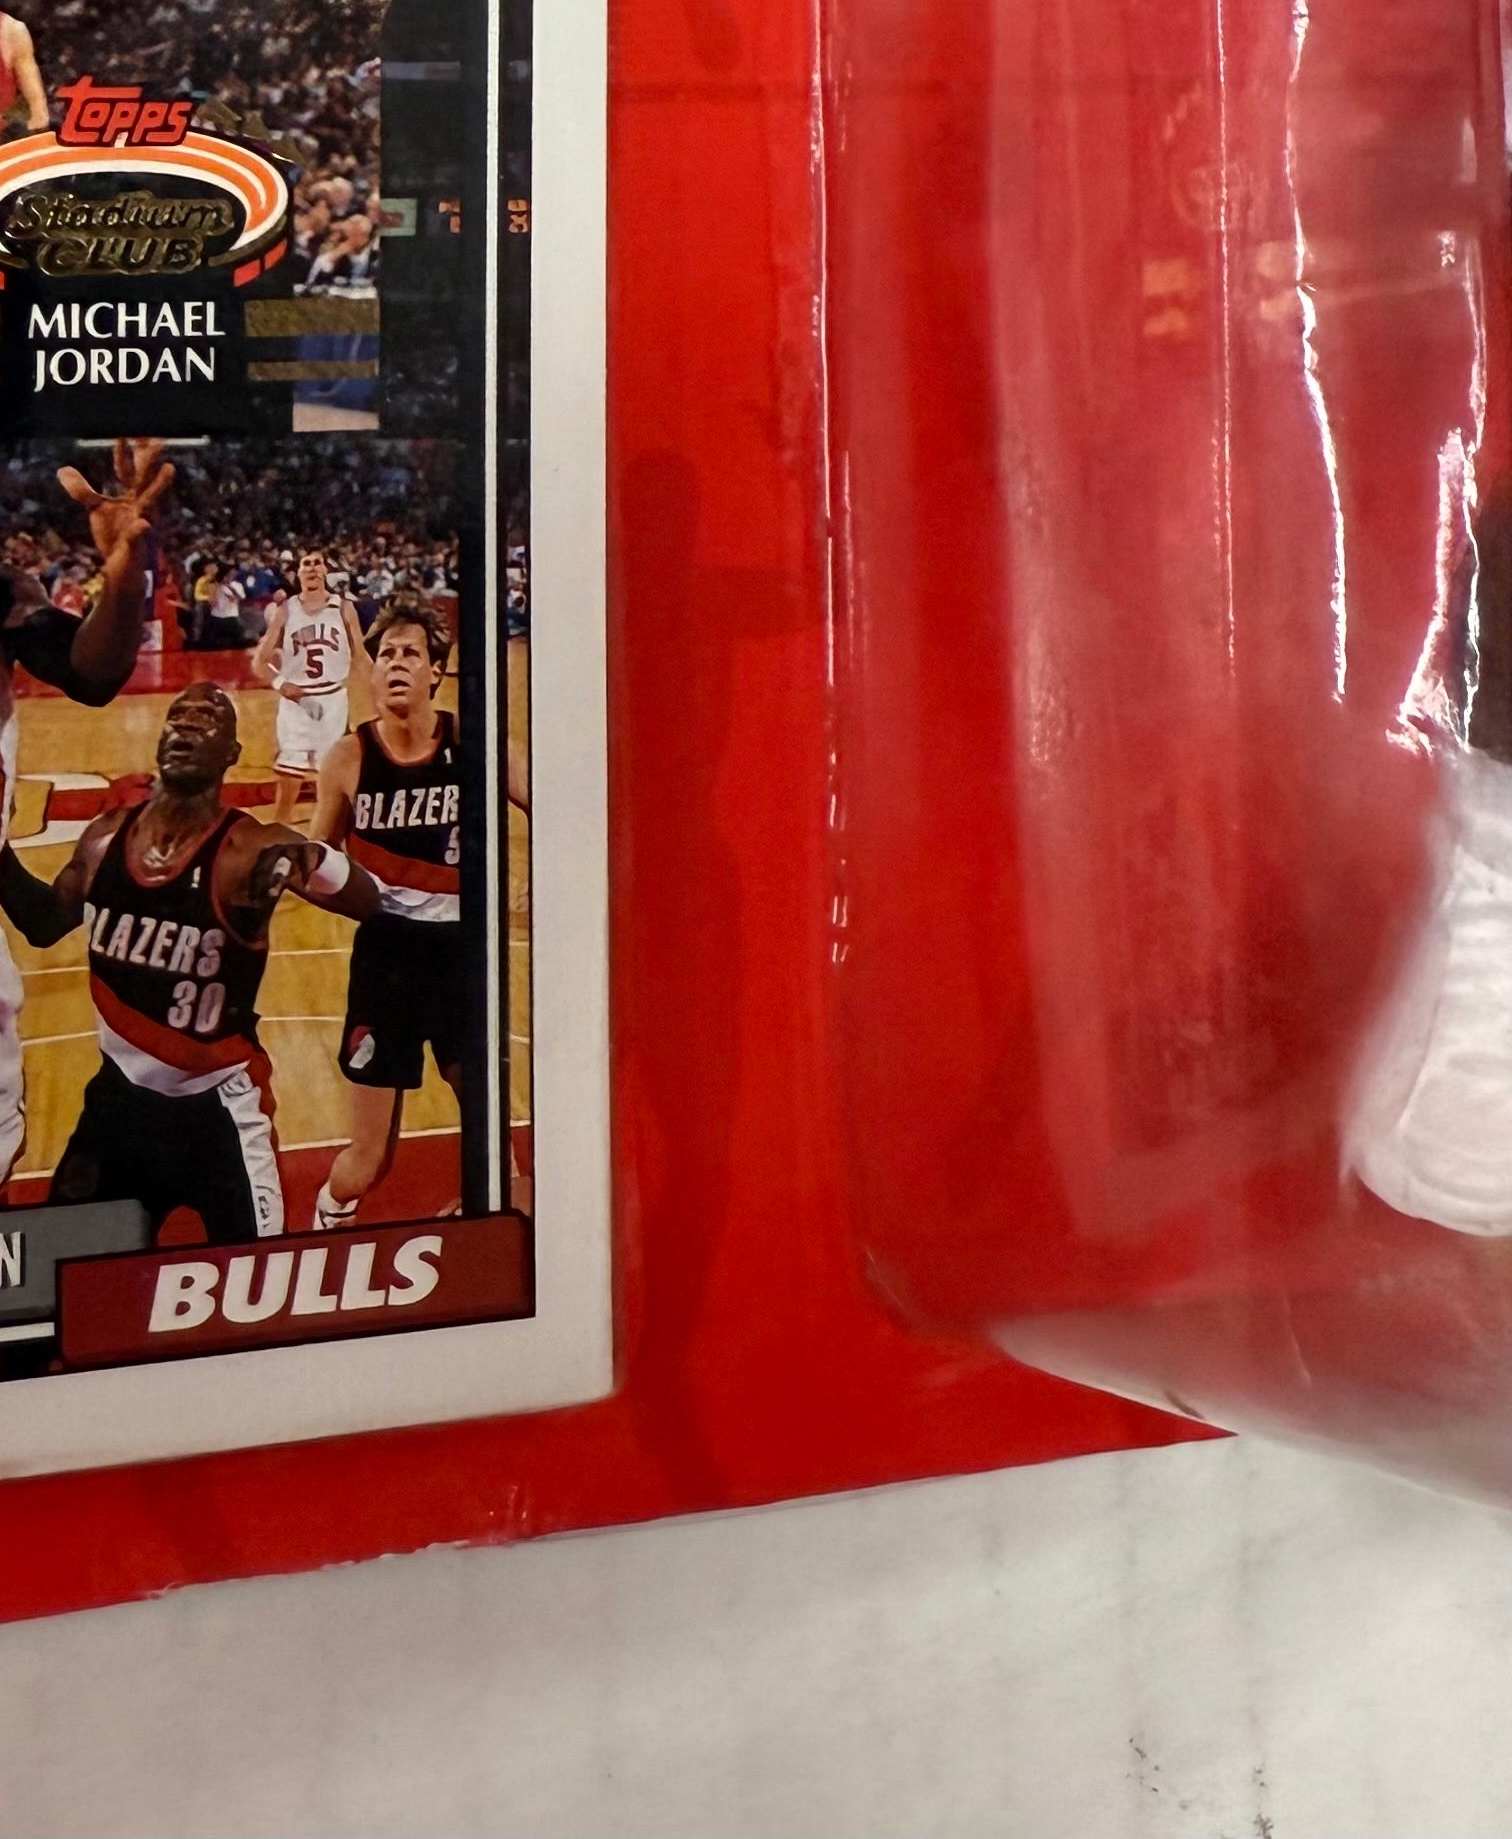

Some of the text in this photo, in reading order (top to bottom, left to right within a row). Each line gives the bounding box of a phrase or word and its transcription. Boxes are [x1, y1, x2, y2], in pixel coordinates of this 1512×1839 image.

[28, 301, 226, 339] MICHAEL
[34, 346, 216, 393] JORDAN
[305, 648, 324, 679] 5
[354, 784, 460, 830] BLAZER
[167, 980, 226, 1034] 30
[148, 1234, 444, 1333] BULLS
